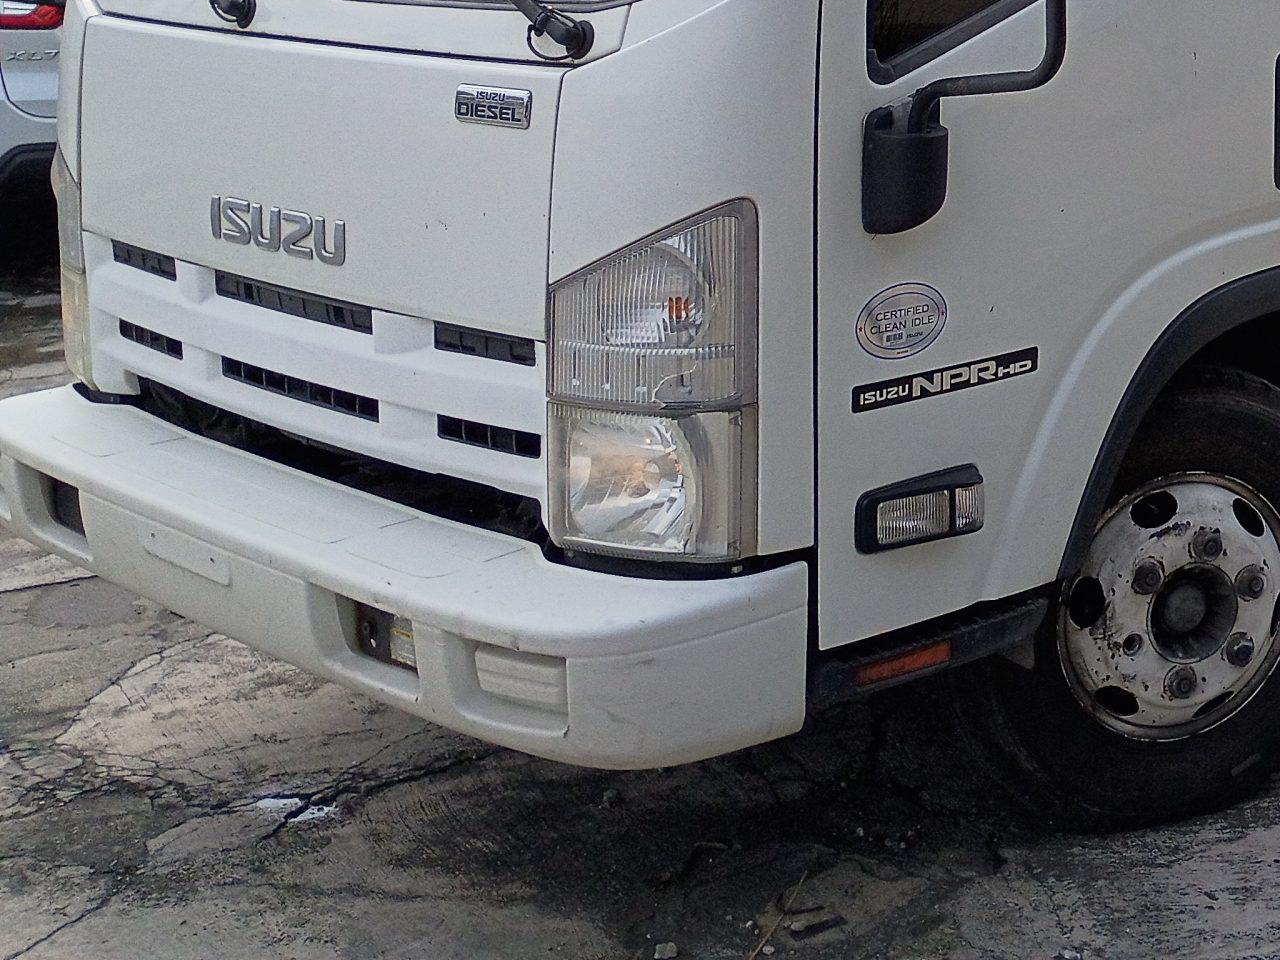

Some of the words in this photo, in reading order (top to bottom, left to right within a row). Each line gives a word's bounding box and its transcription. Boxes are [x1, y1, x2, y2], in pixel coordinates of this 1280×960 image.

[476, 91, 506, 102] ISUZU
[457, 101, 523, 123] DIESEL
[210, 194, 347, 267] ISUZU
[875, 303, 930, 323] CERTIFIED
[870, 319, 907, 336] CLEAN
[911, 313, 935, 328] IDLE
[859, 384, 909, 406] ISUZU
